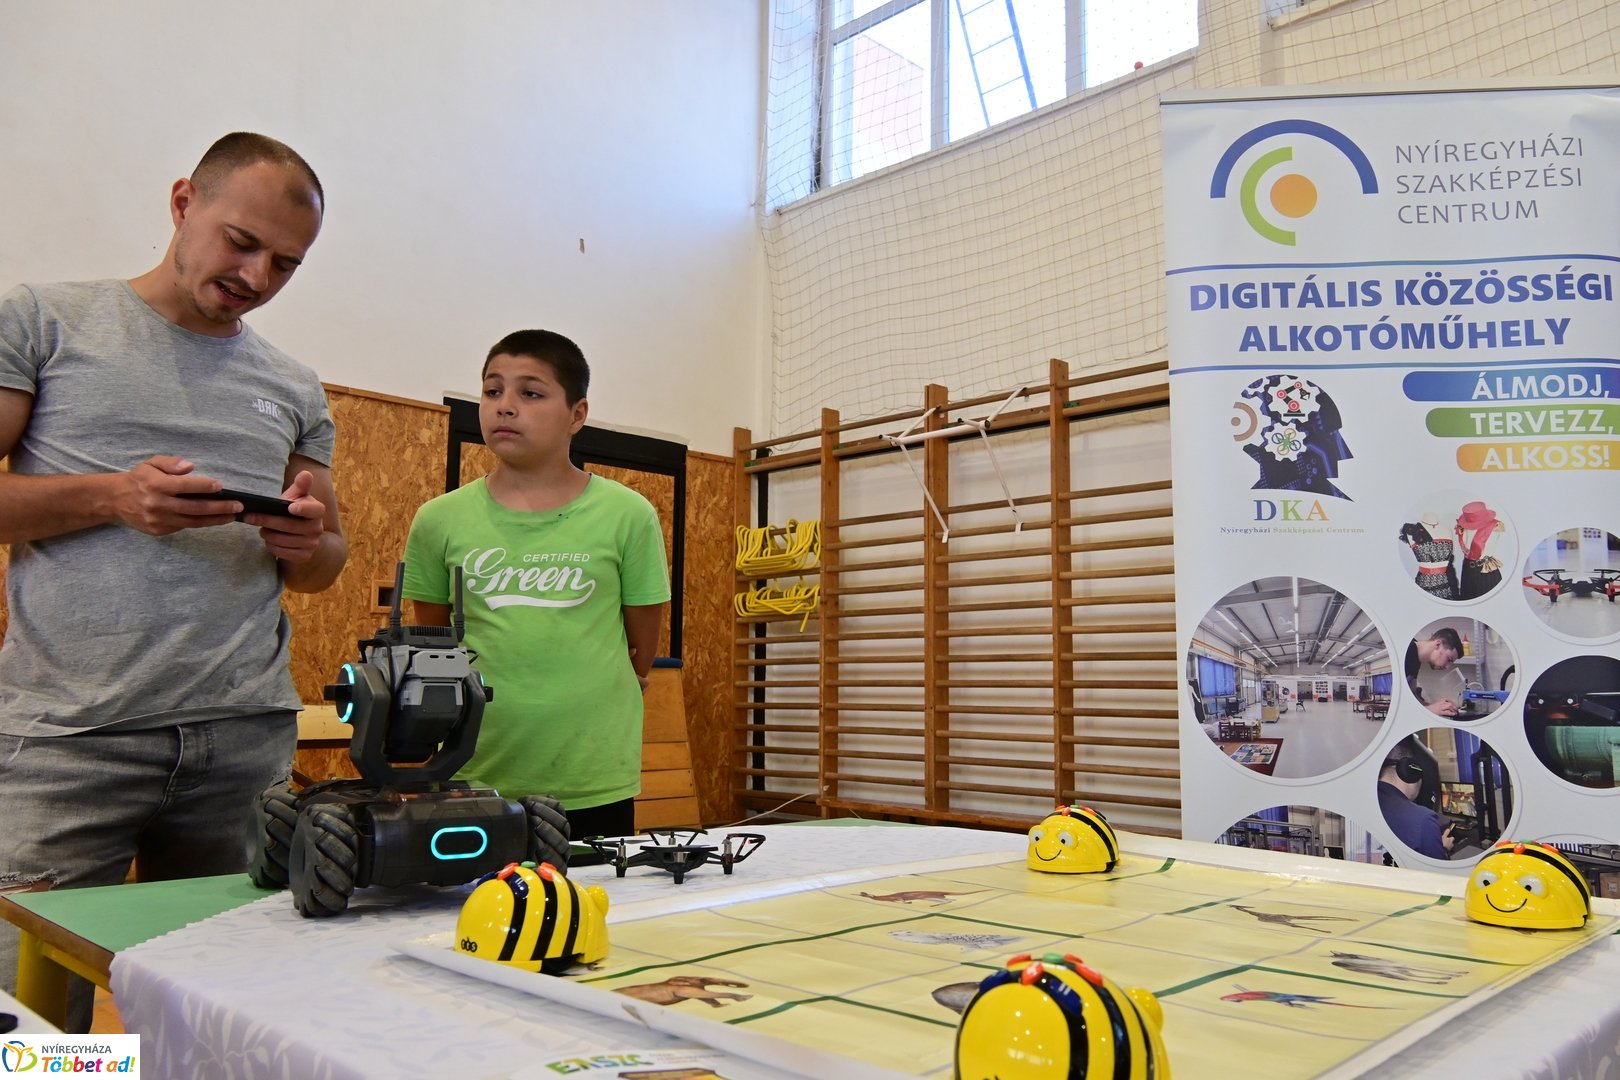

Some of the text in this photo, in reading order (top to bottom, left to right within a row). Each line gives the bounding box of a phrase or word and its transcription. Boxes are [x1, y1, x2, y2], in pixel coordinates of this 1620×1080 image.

[1395, 135, 1584, 164] NYÍREGYHÁZI
[1396, 166, 1583, 195] SZAKKÉPZÉSI
[1398, 200, 1540, 225] CENTRUM
[1190, 265, 1613, 311] DIGITÁLIS KÖZÖSSÉGI
[1238, 314, 1572, 352] ALKOTÓMŰHELY
[1471, 371, 1610, 400] ÁLMODJ,
[1470, 409, 1614, 435] TERVEZZ,
[1481, 445, 1611, 470] ALKOSS!
[1253, 499, 1330, 521] DKA
[462, 547, 596, 594] Green
[523, 553, 590, 563] CERTIFIED
